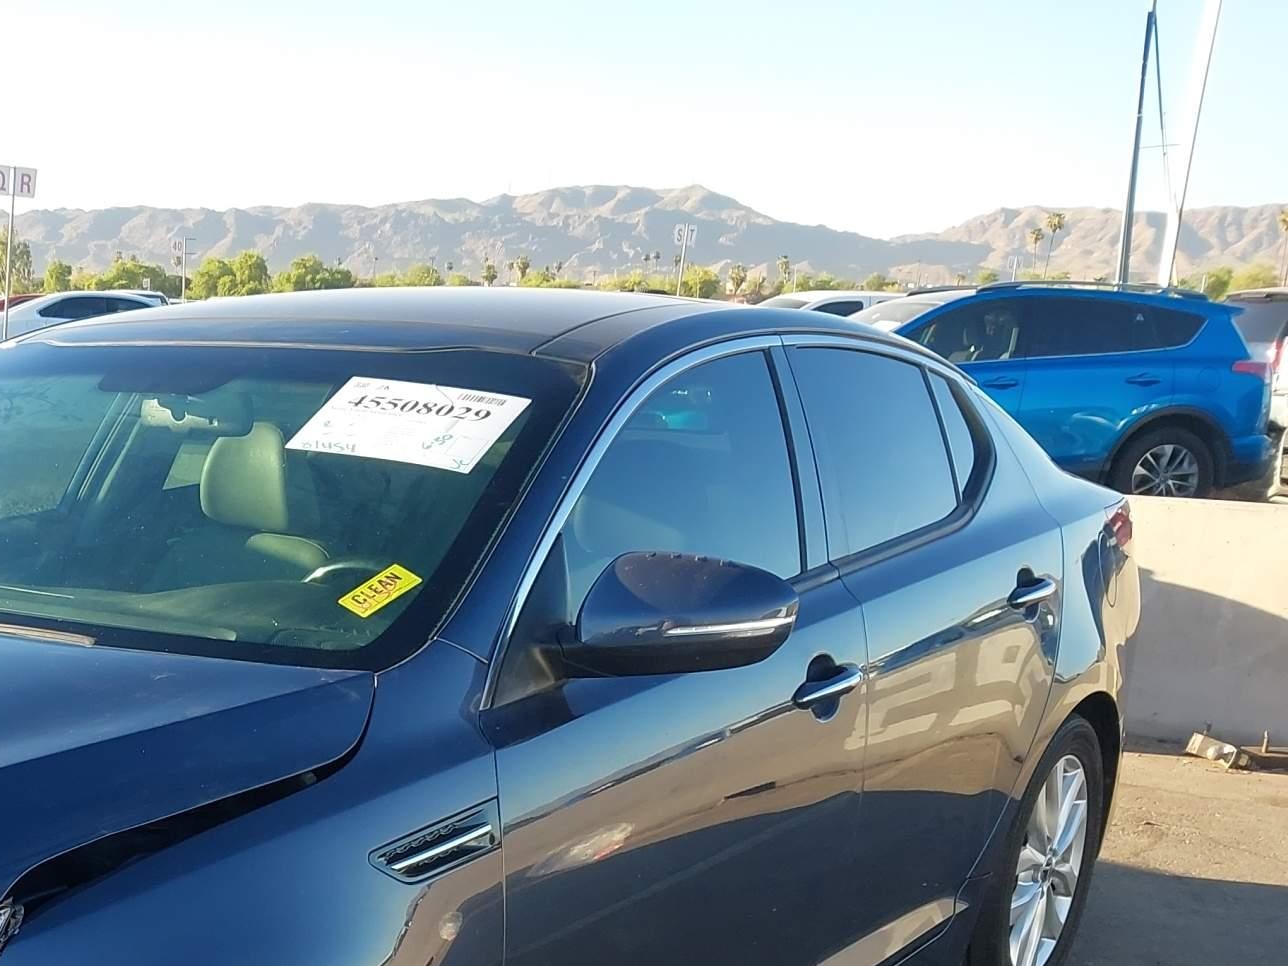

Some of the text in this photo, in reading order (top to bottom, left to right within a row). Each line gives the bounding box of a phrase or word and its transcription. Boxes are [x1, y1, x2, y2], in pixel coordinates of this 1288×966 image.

[21, 173, 31, 193] R
[348, 395, 491, 421] 45508029
[351, 572, 402, 604] CLEAN
